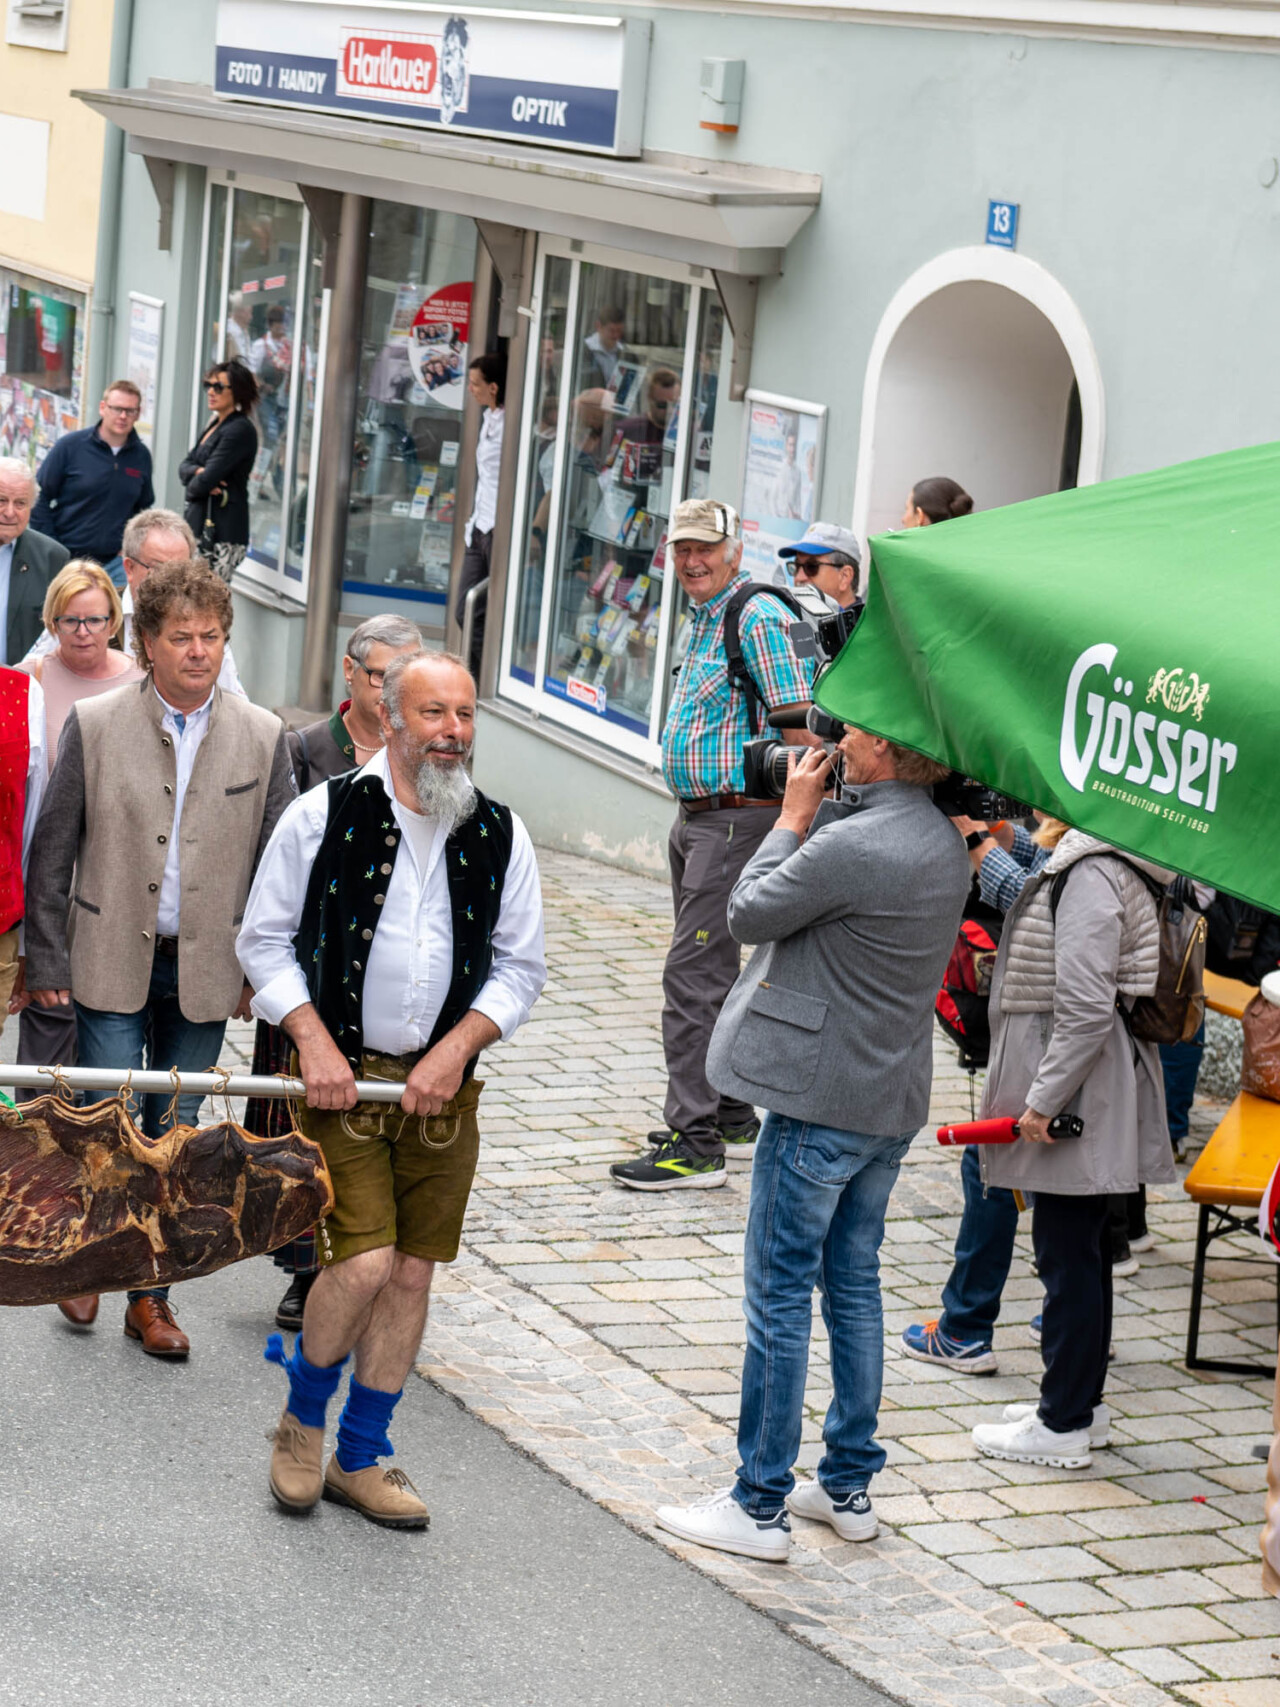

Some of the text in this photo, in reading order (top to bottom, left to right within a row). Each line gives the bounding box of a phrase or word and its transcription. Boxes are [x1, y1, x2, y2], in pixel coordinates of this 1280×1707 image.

[228, 61, 262, 86] FOTO
[278, 67, 327, 94] HANDY
[349, 41, 432, 92] Hartlauer
[511, 96, 567, 127] OPTIK
[993, 205, 1010, 233] 13
[1060, 643, 1238, 812] Gösser
[1092, 780, 1210, 834] BRAUTRADITION SEIT 1860
